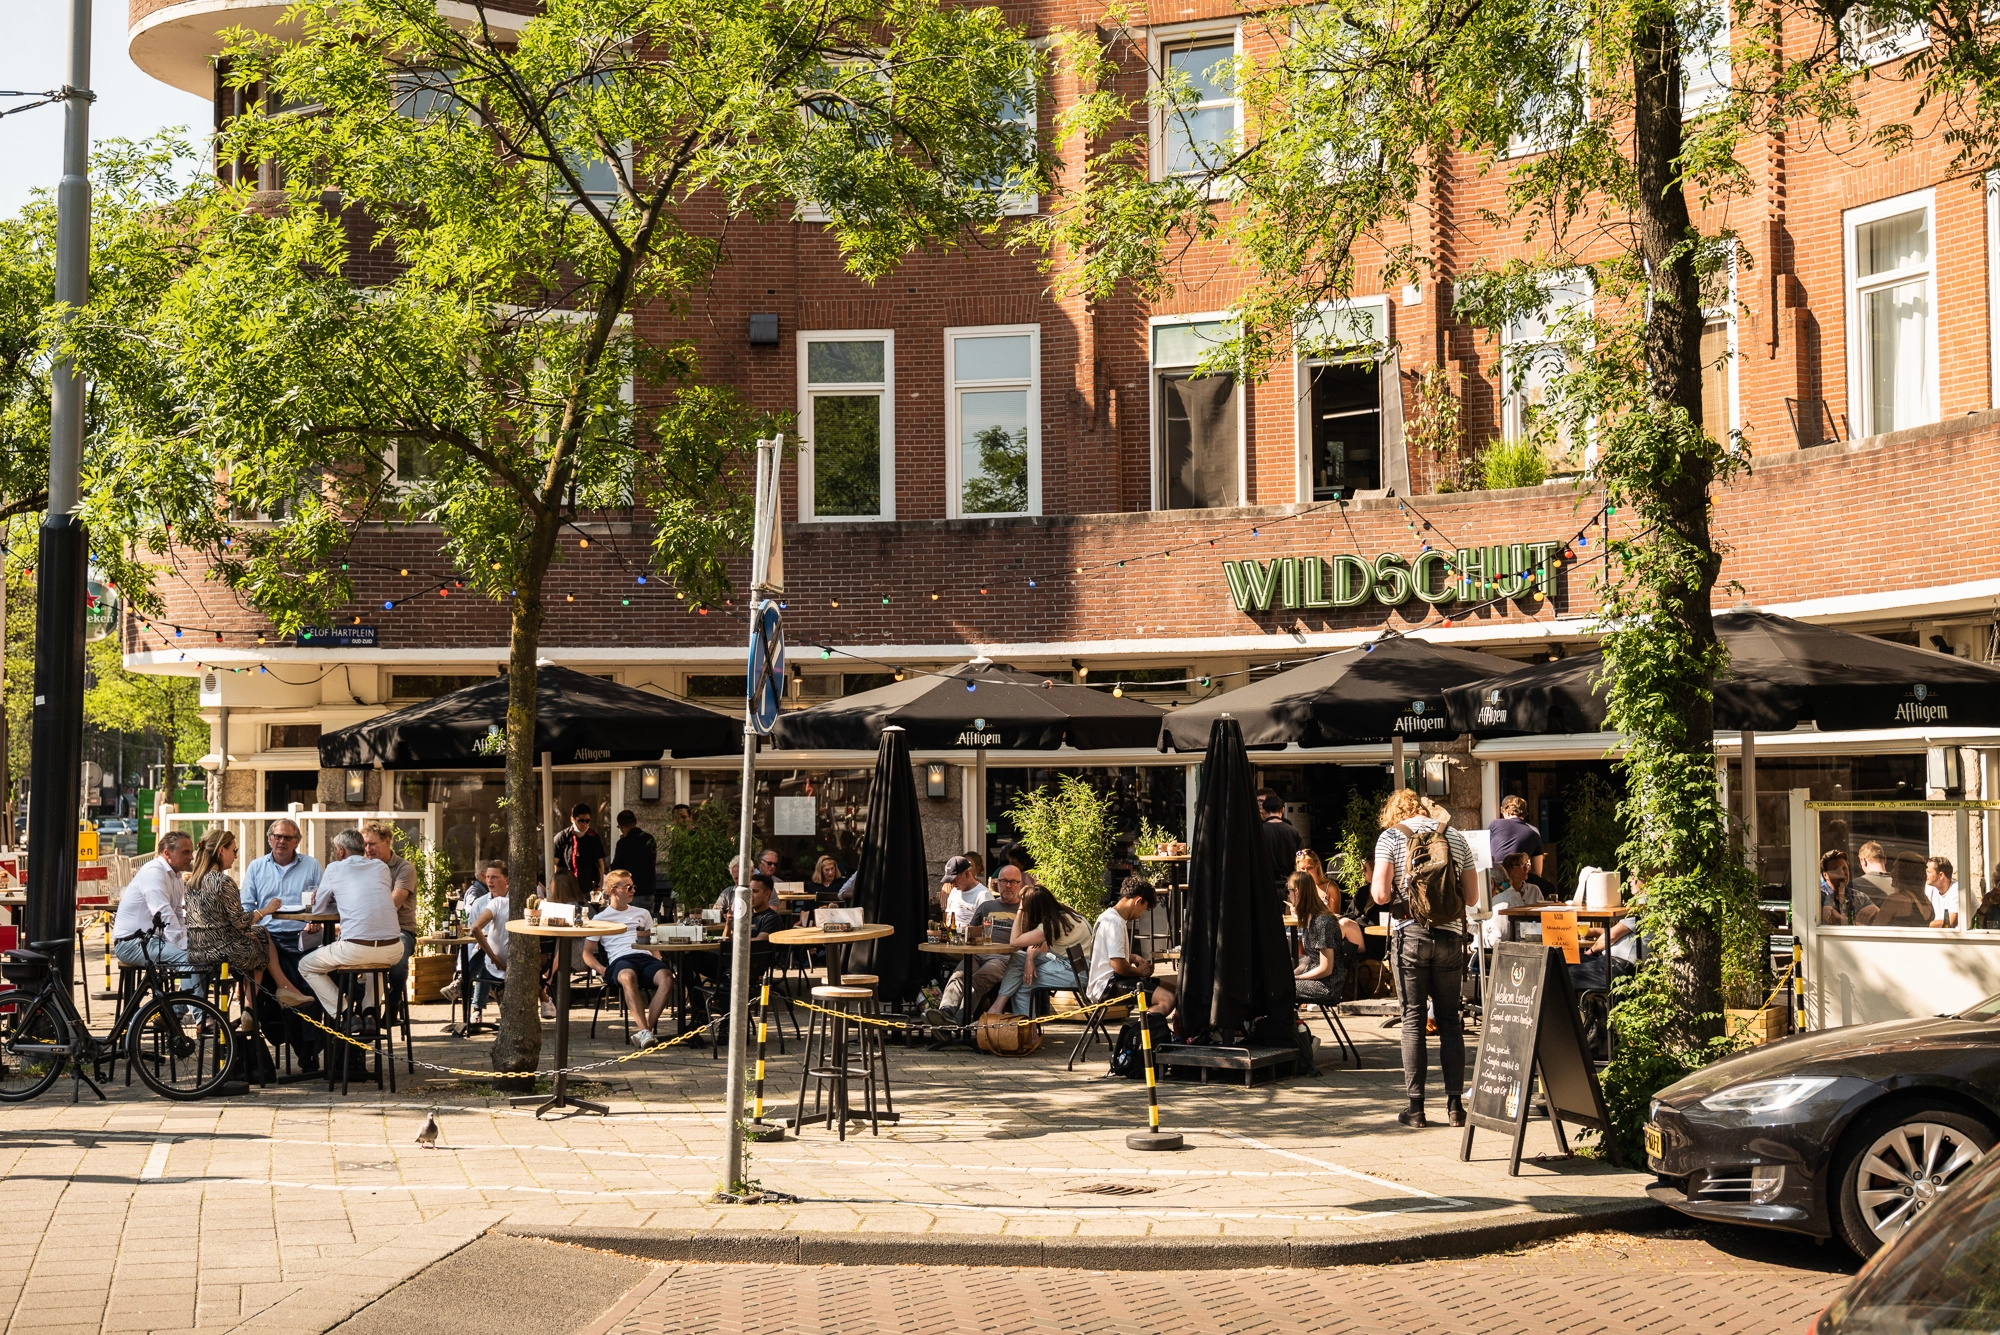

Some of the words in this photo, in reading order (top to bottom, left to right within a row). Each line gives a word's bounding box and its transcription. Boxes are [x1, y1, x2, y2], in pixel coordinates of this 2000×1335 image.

[1222, 541, 1560, 611] WILDSCHUT
[299, 628, 330, 637] RELOF
[331, 628, 374, 637] HARTPLEIN
[1478, 706, 1507, 726] Affligem
[1894, 702, 1948, 722] Affligem
[1393, 716, 1444, 733] Affligem
[956, 731, 1002, 747] Affligem
[573, 748, 611, 761] Affligem
